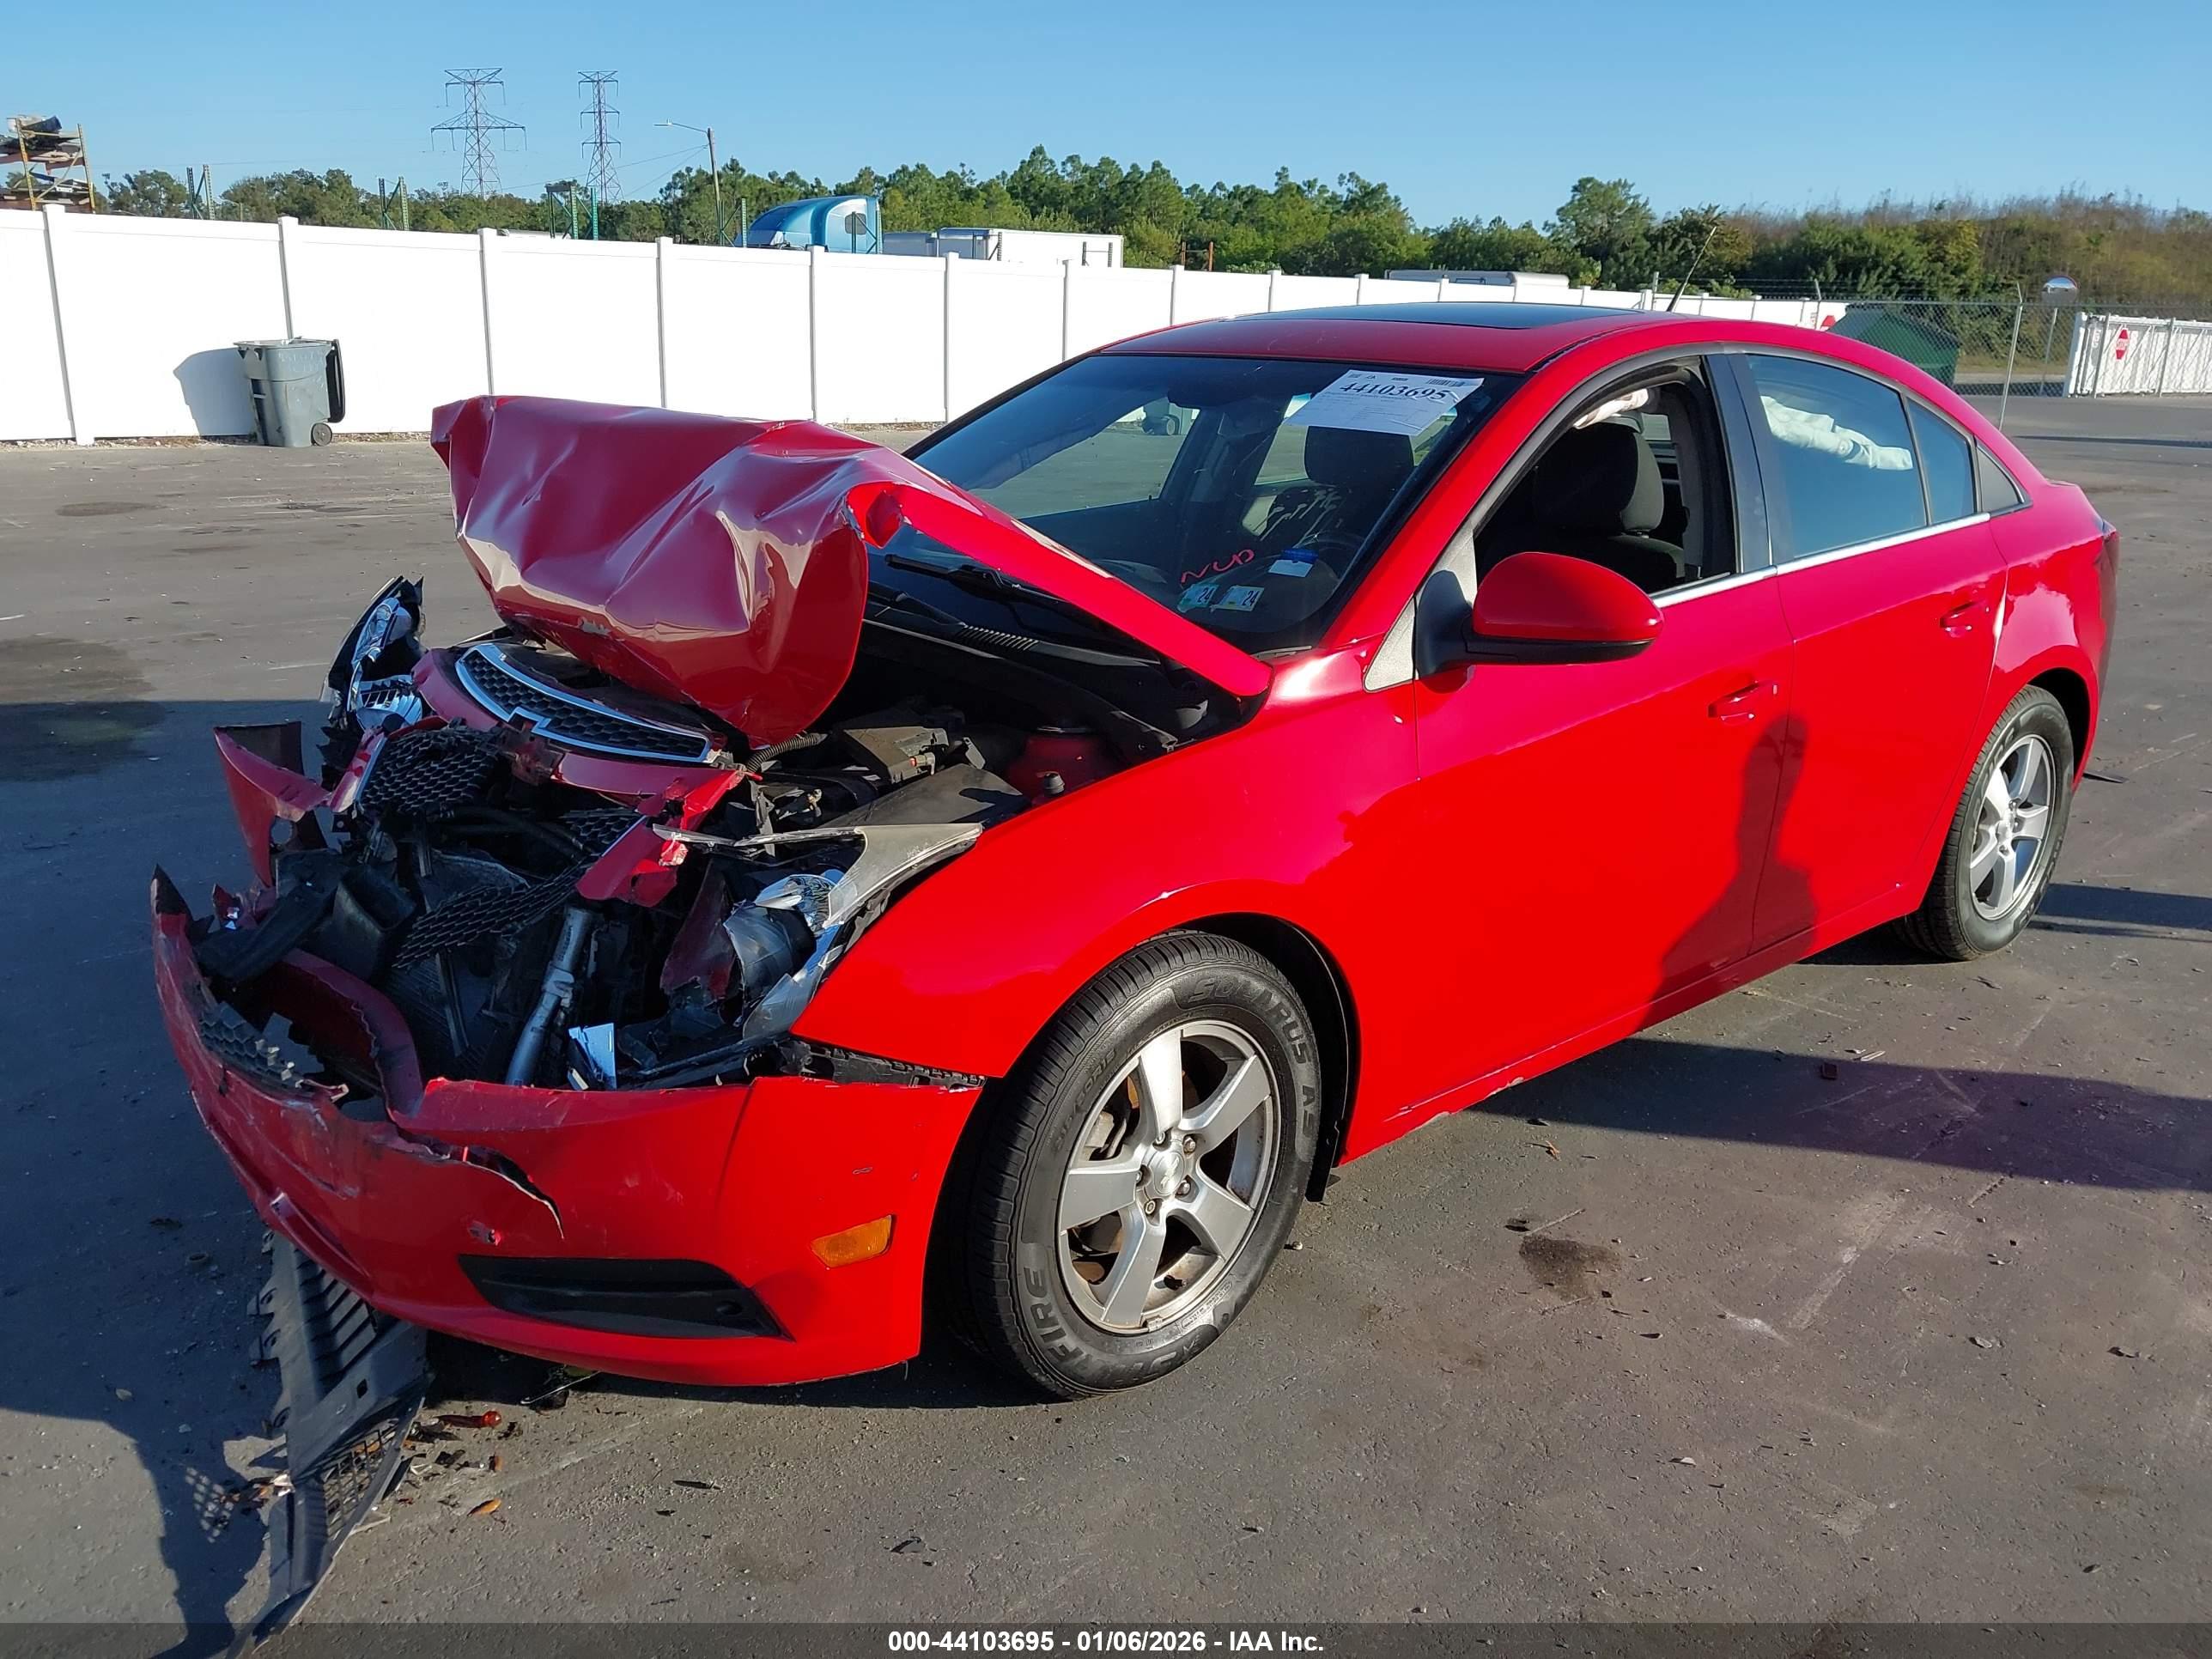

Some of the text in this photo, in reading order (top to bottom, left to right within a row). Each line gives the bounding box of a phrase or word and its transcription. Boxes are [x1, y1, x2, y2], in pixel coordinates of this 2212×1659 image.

[1340, 382, 1451, 400] 44103695
[1197, 587, 1215, 603] 24
[1242, 590, 1260, 606] 24
